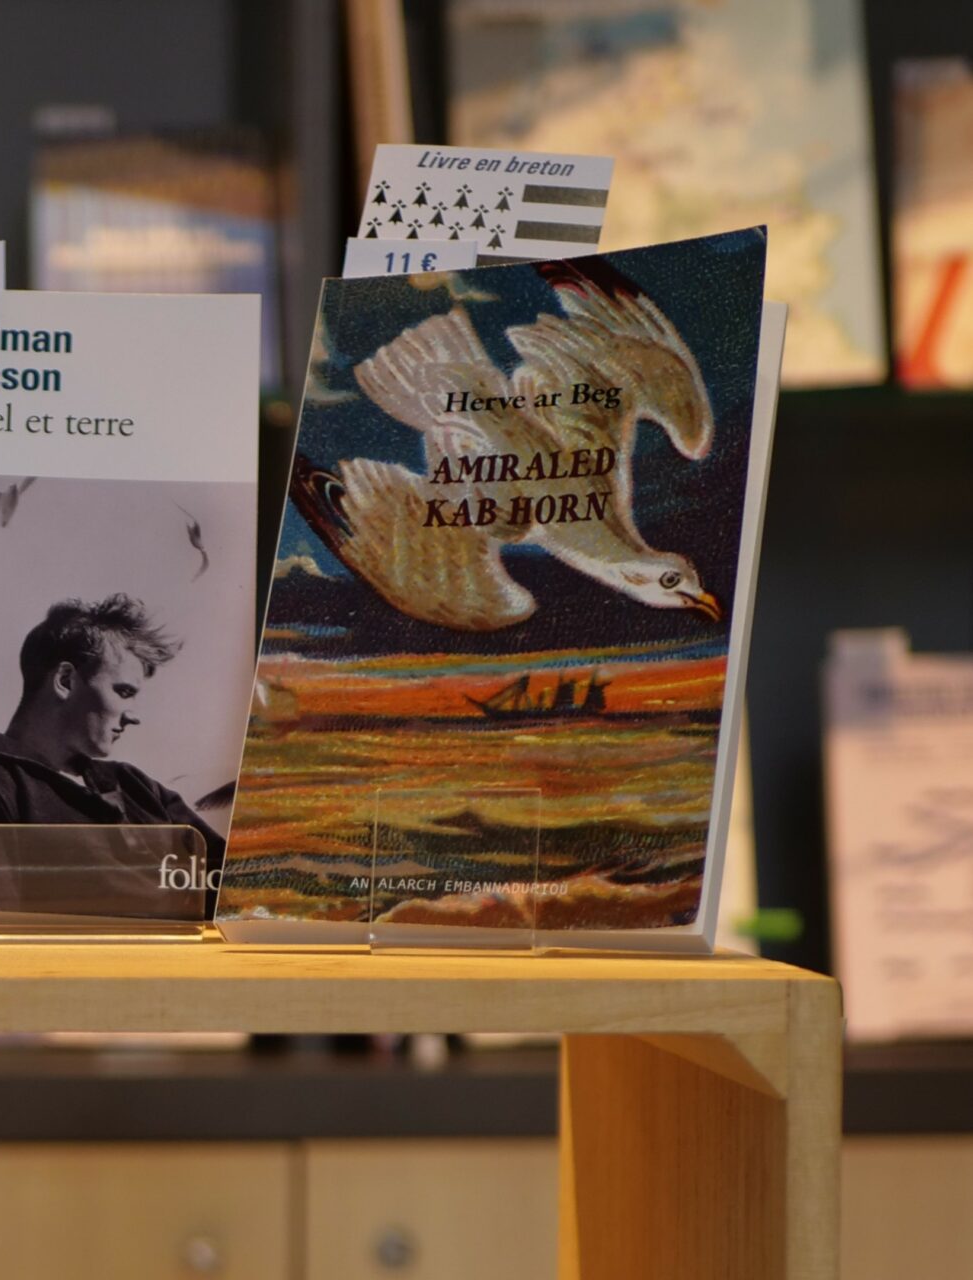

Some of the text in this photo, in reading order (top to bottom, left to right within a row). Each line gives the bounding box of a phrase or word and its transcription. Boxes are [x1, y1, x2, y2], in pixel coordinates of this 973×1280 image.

[417, 151, 575, 177] Livre en breton
[384, 252, 438, 273] 11 €
[444, 382, 623, 413] Herve ar Beg
[25, 413, 54, 434] et
[65, 414, 134, 437] terre
[430, 447, 616, 484] AMIRALED
[422, 492, 612, 528] KAB HORN
[350, 877, 369, 889] AN
